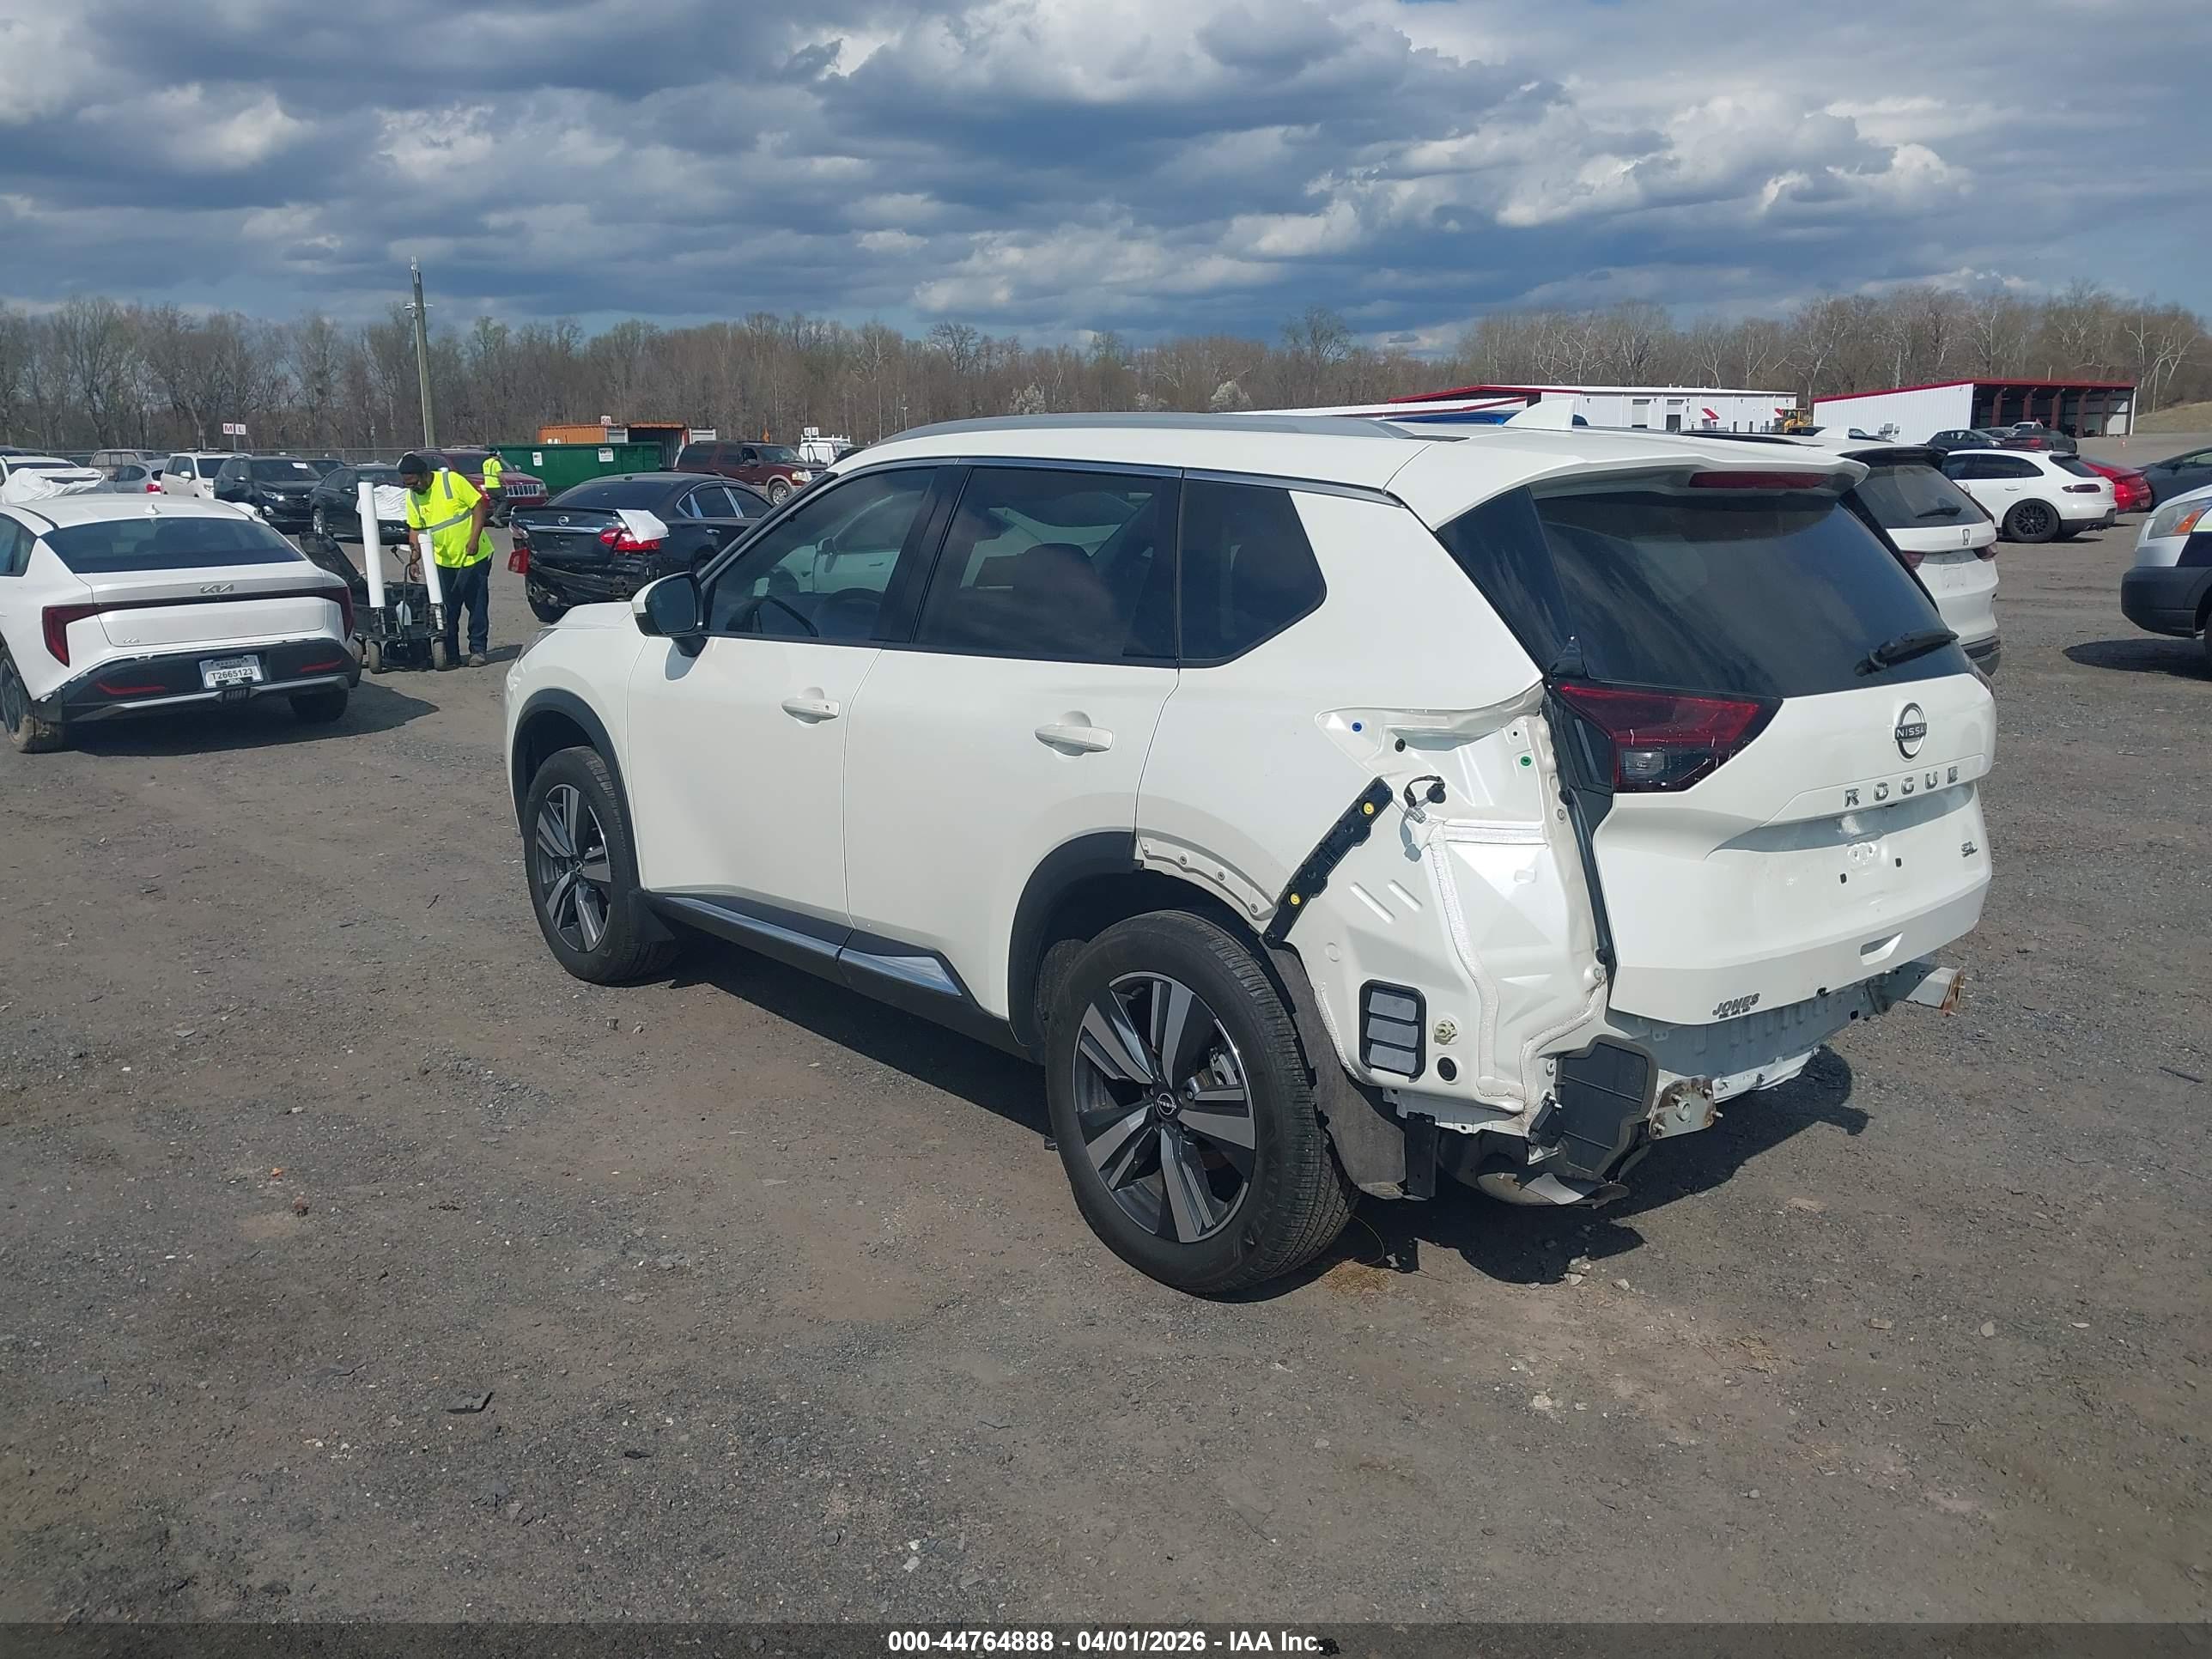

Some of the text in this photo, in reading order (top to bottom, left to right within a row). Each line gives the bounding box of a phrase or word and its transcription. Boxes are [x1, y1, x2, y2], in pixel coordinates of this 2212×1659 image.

[199, 583, 234, 594] KIA
[211, 667, 253, 681] T2665123
[1844, 765, 1959, 807] ROGUE
[1961, 841, 1978, 858] SL
[1711, 993, 1760, 1016] JONES
